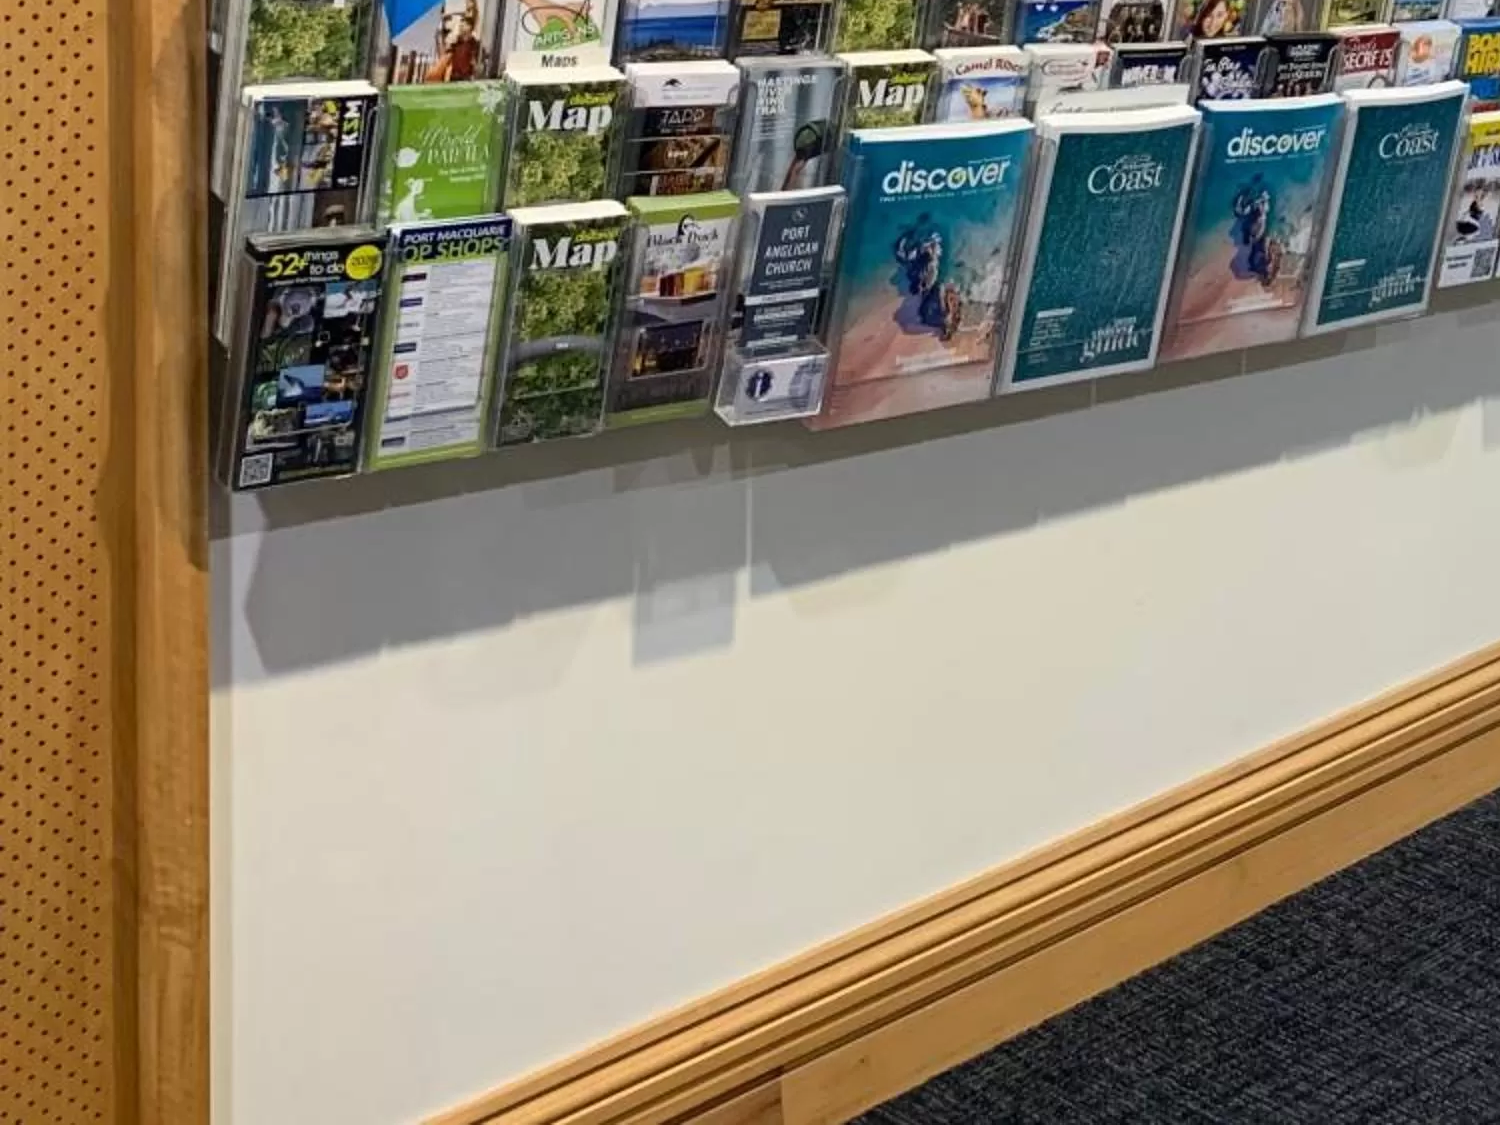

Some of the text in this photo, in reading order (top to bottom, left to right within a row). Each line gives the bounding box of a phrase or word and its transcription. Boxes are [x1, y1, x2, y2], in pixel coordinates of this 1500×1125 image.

[541, 54, 579, 68] Maps
[956, 62, 993, 77] Camel
[856, 78, 925, 112] Map
[527, 99, 612, 135] Map
[1226, 127, 1325, 157] discover
[1379, 129, 1438, 159] Coast
[882, 160, 1010, 194] discover
[1087, 163, 1164, 195] Coast
[403, 225, 506, 245] PORT MACQUARIE
[781, 225, 811, 240] PORT
[403, 237, 503, 262] OP SHOPS
[531, 237, 616, 271] Map
[765, 242, 819, 258] ANGLICAN
[310, 262, 345, 276] to do
[765, 259, 812, 276] CHURCH
